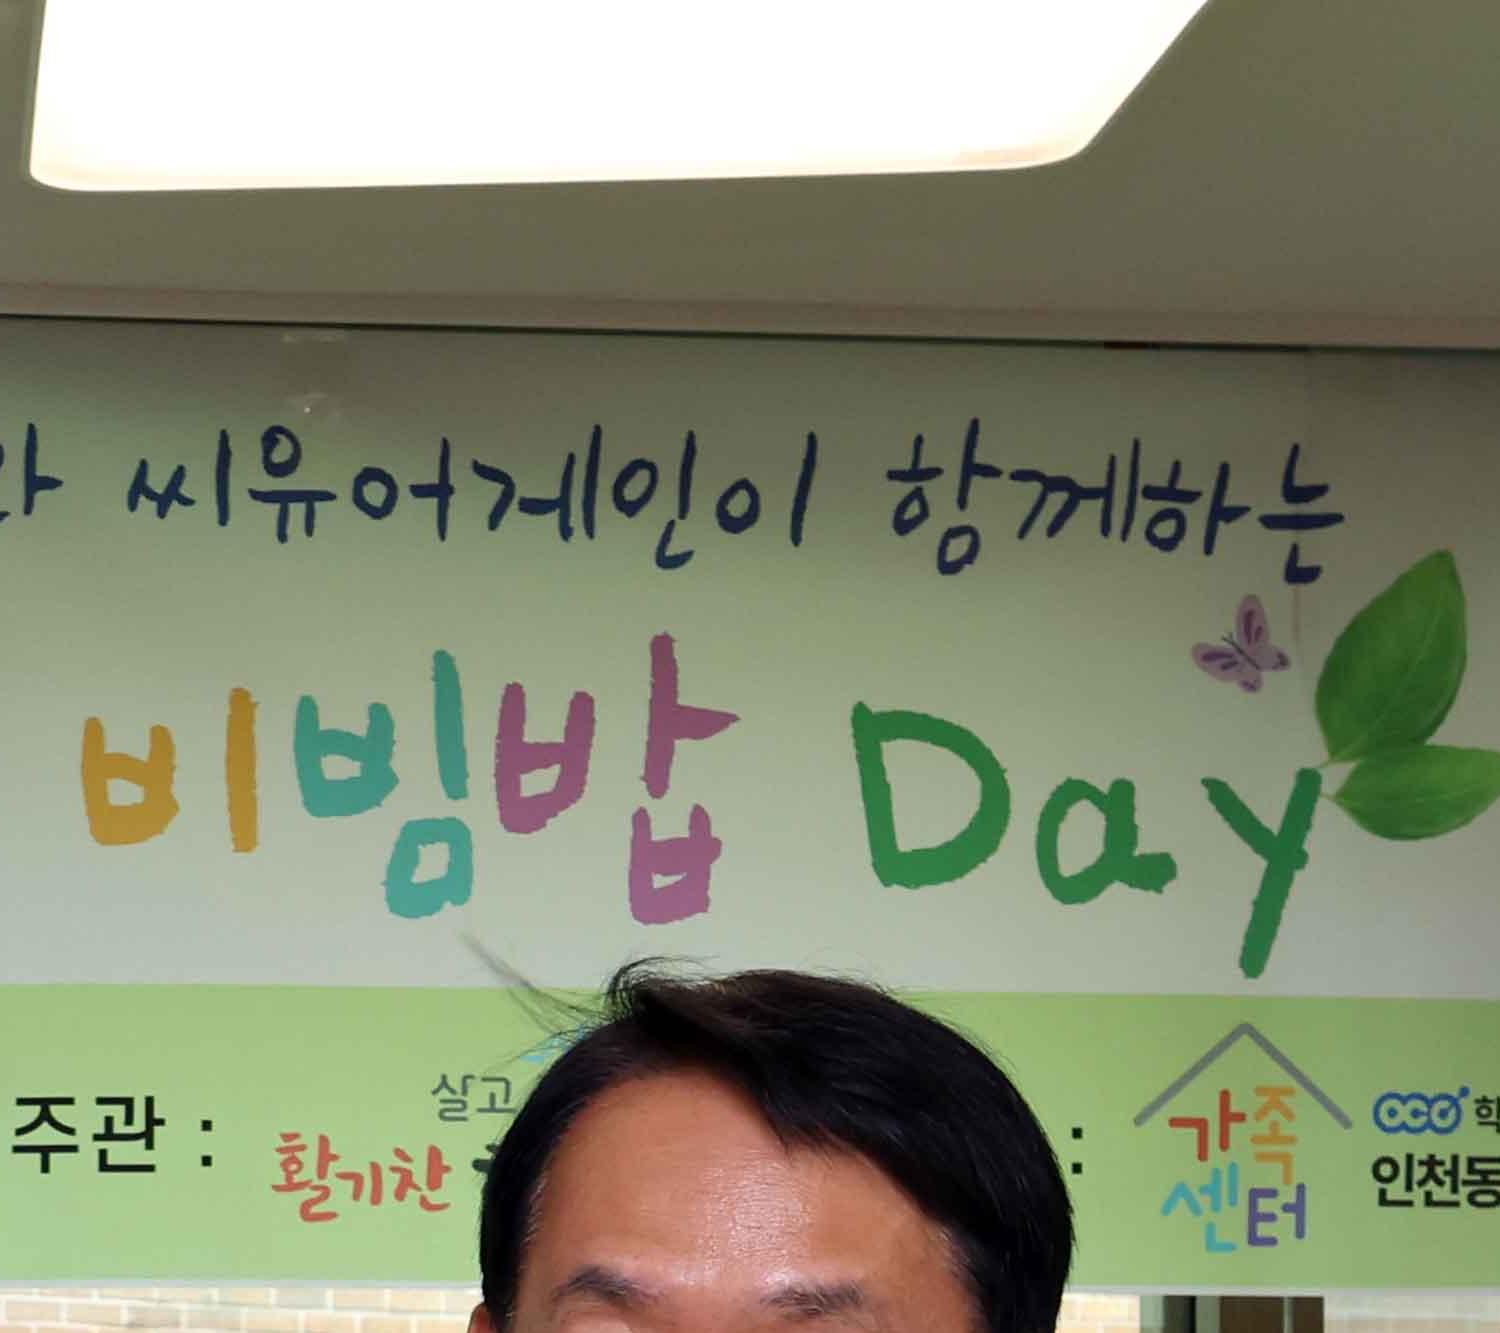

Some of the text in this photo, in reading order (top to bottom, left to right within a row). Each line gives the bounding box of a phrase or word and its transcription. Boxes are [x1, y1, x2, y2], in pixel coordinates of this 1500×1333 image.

[126, 425, 820, 573] 씨유어게인이
[885, 416, 1346, 587] 함께하는
[80, 630, 741, 926] 비빔밥
[850, 700, 1323, 980] Day
[10, 1094, 166, 1176] 주관
[431, 1073, 519, 1123] 살고
[1168, 1086, 1298, 1185] 가족
[271, 1132, 453, 1223] 활기찬
[1160, 1160, 1307, 1254] 센터
